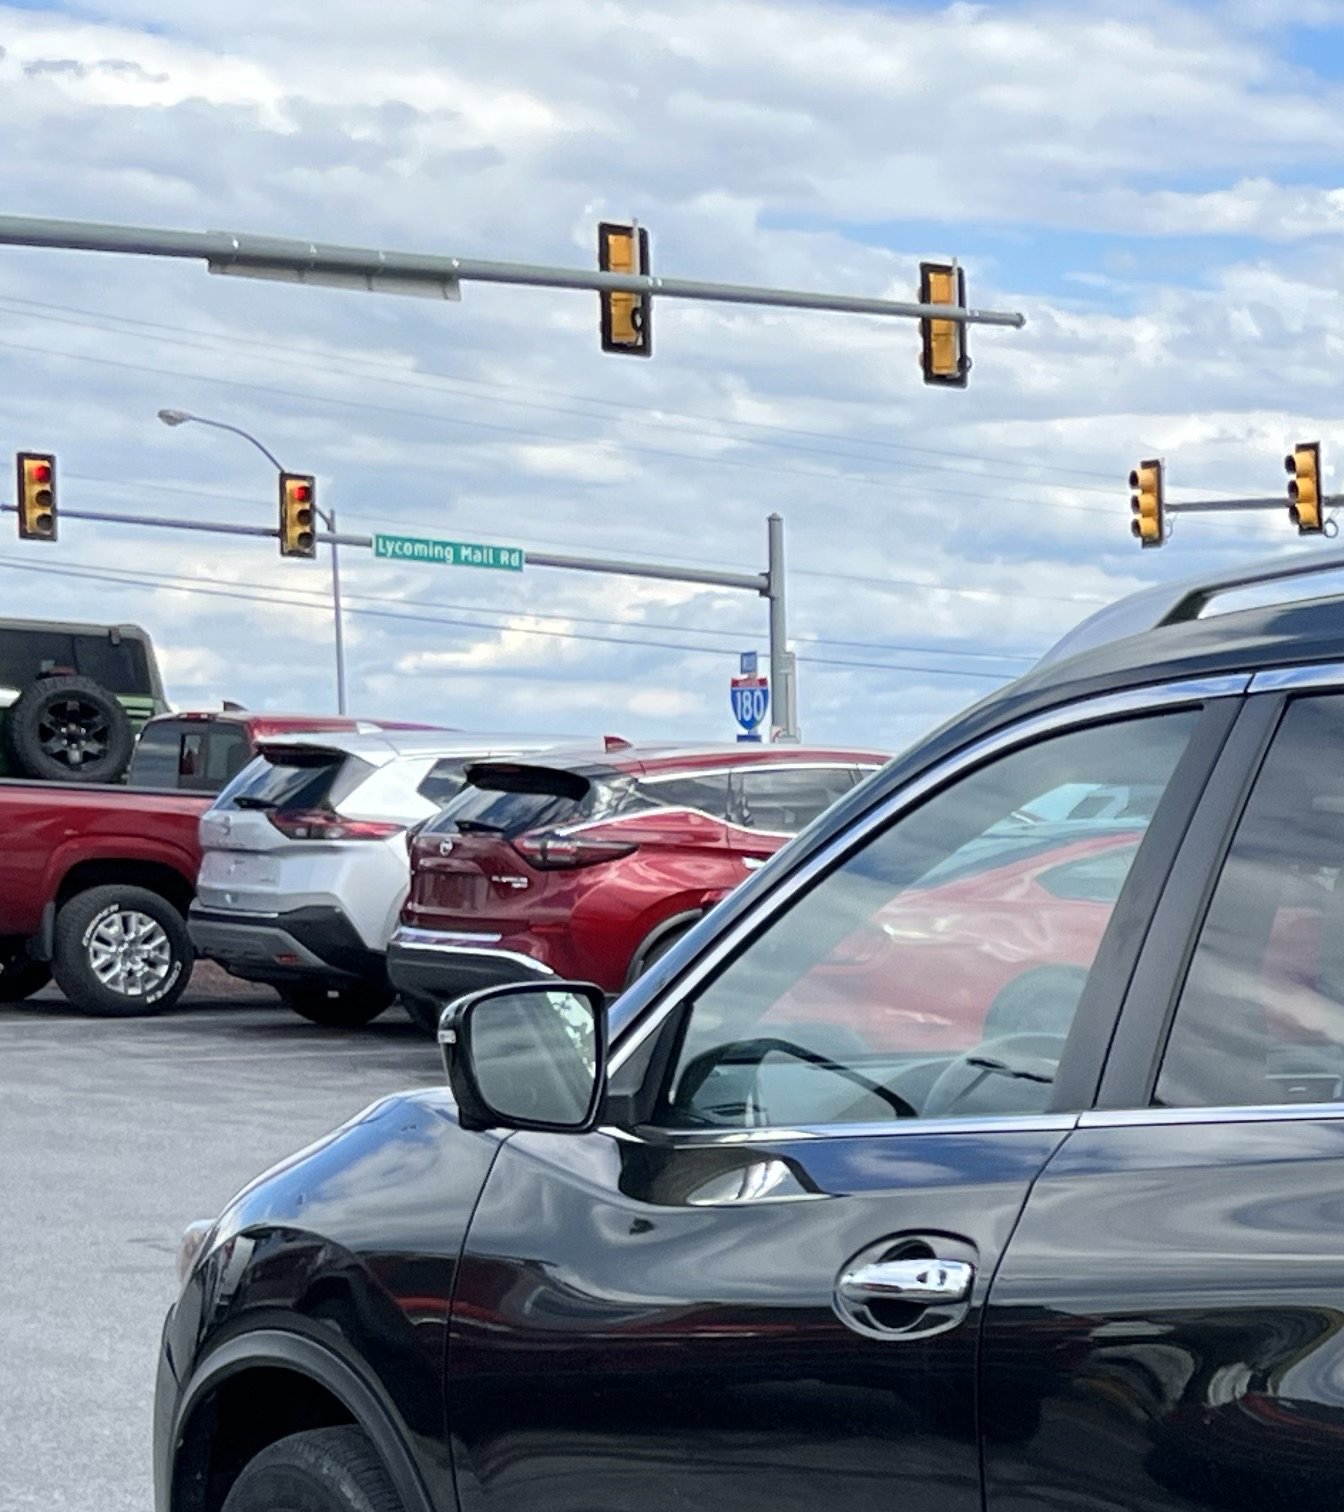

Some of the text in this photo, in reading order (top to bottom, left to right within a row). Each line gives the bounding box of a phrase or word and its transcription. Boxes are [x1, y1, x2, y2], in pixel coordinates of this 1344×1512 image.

[378, 537, 520, 566] Lycoming Mall Rd
[736, 690, 765, 721] 180
